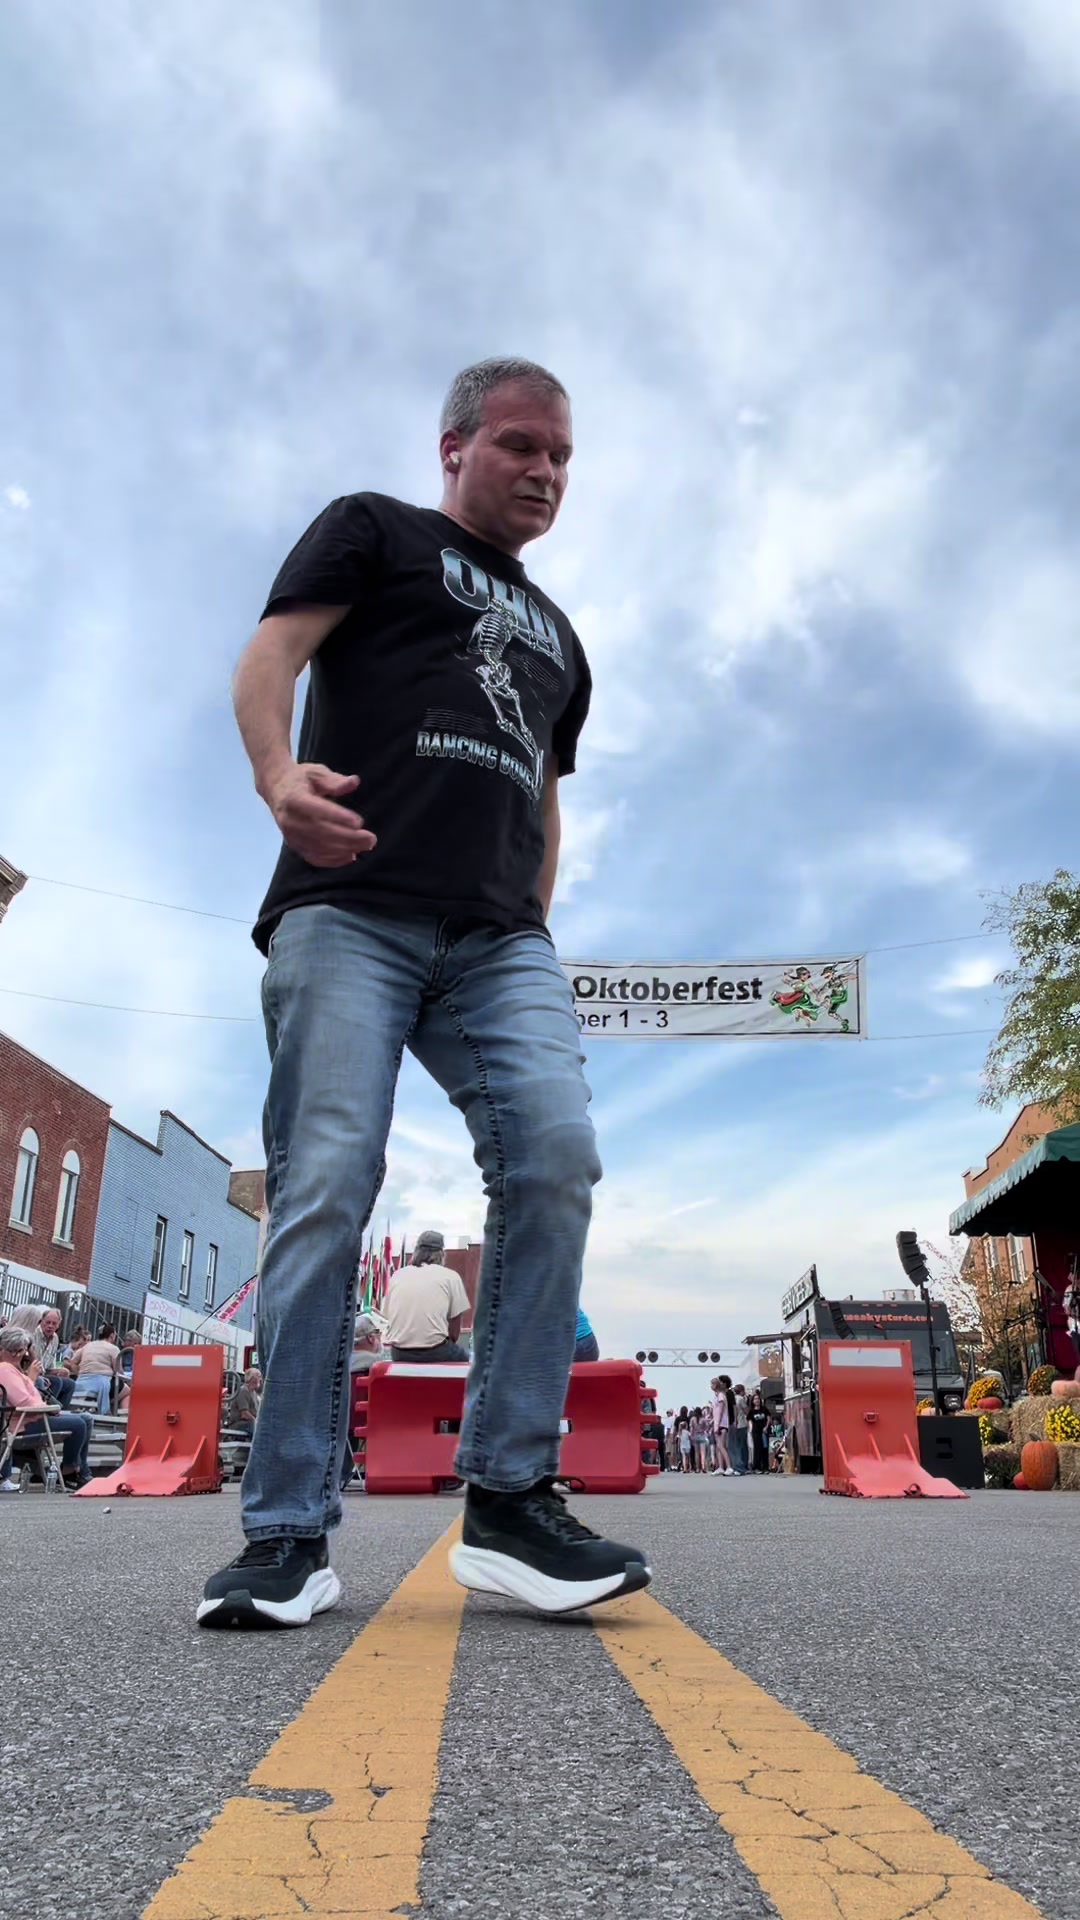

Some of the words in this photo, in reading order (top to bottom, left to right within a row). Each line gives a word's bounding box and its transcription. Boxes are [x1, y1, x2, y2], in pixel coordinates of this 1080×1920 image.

[416, 731, 498, 769] DANCING
[499, 750, 537, 800] BONE
[573, 975, 763, 1001] Oktoberfest
[619, 1009, 629, 1028] 1
[656, 1010, 669, 1028] 3
